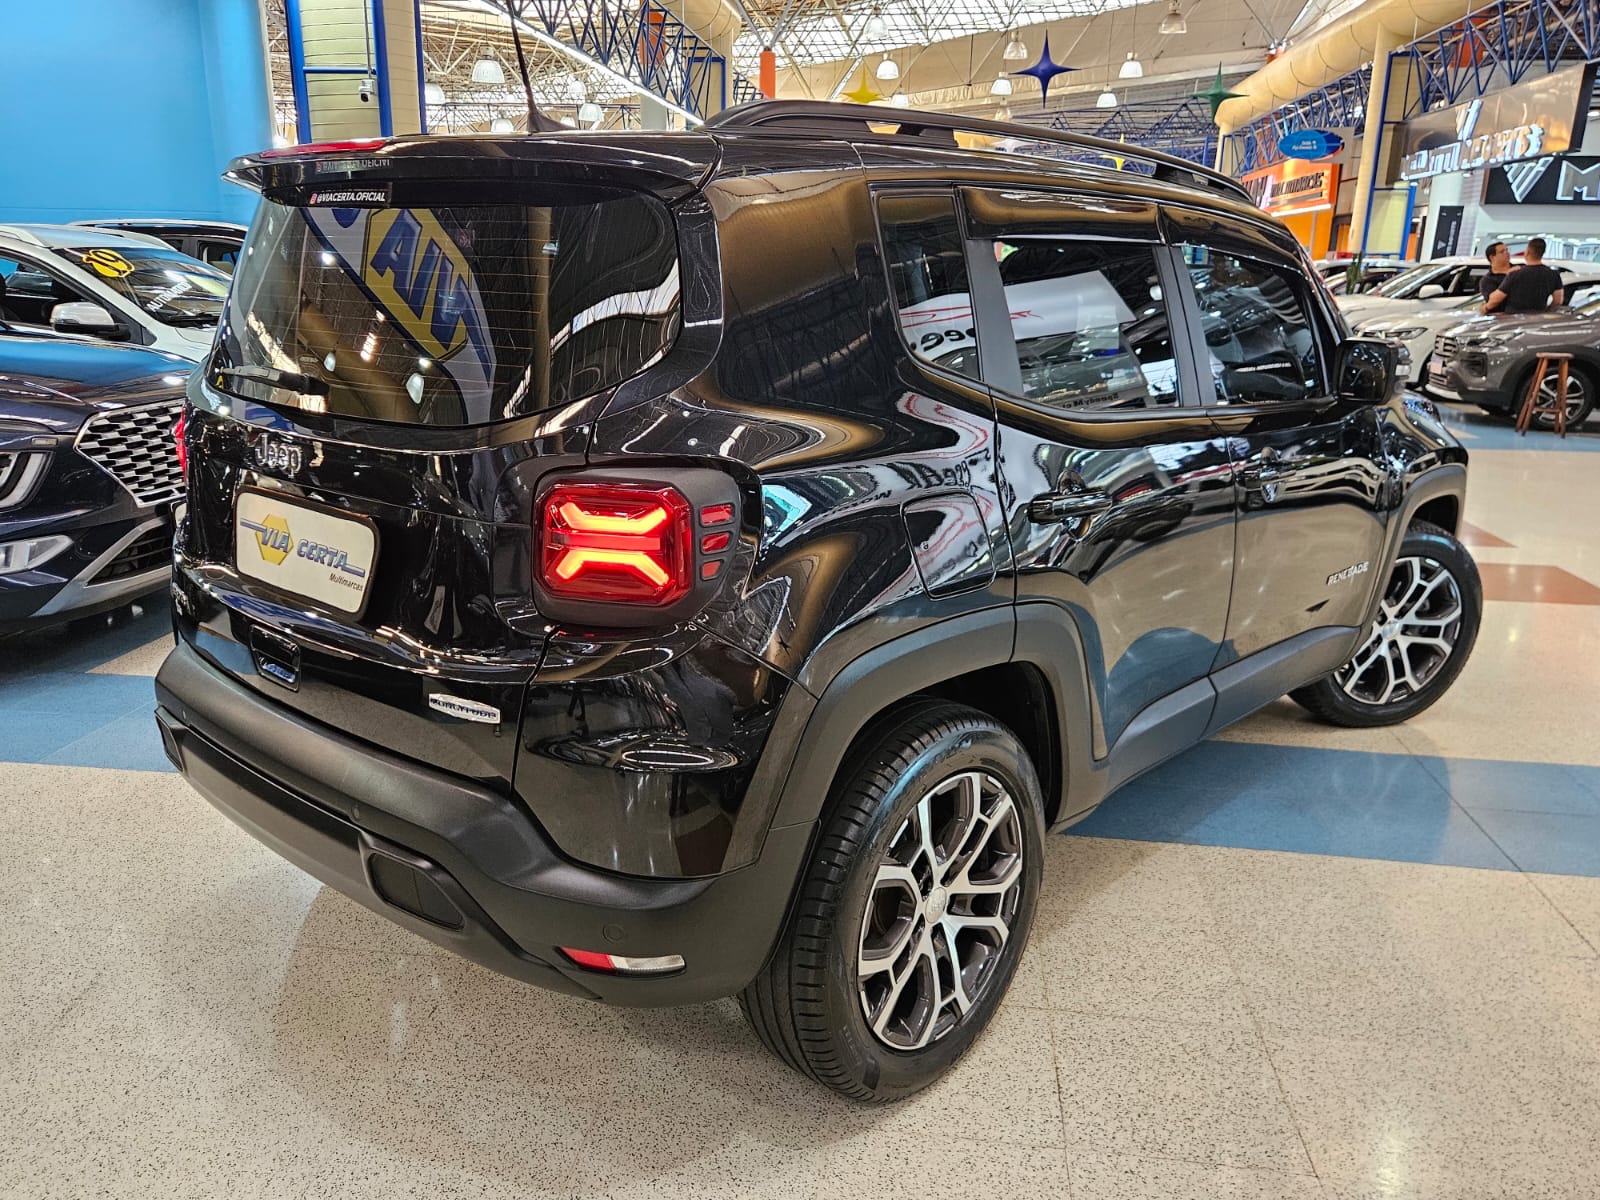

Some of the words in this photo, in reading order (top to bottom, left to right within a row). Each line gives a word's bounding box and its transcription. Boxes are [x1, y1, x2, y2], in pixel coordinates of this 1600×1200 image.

[254, 433, 303, 479] Jeep
[256, 525, 290, 553] VIA
[328, 572, 364, 593] Multimarcas
